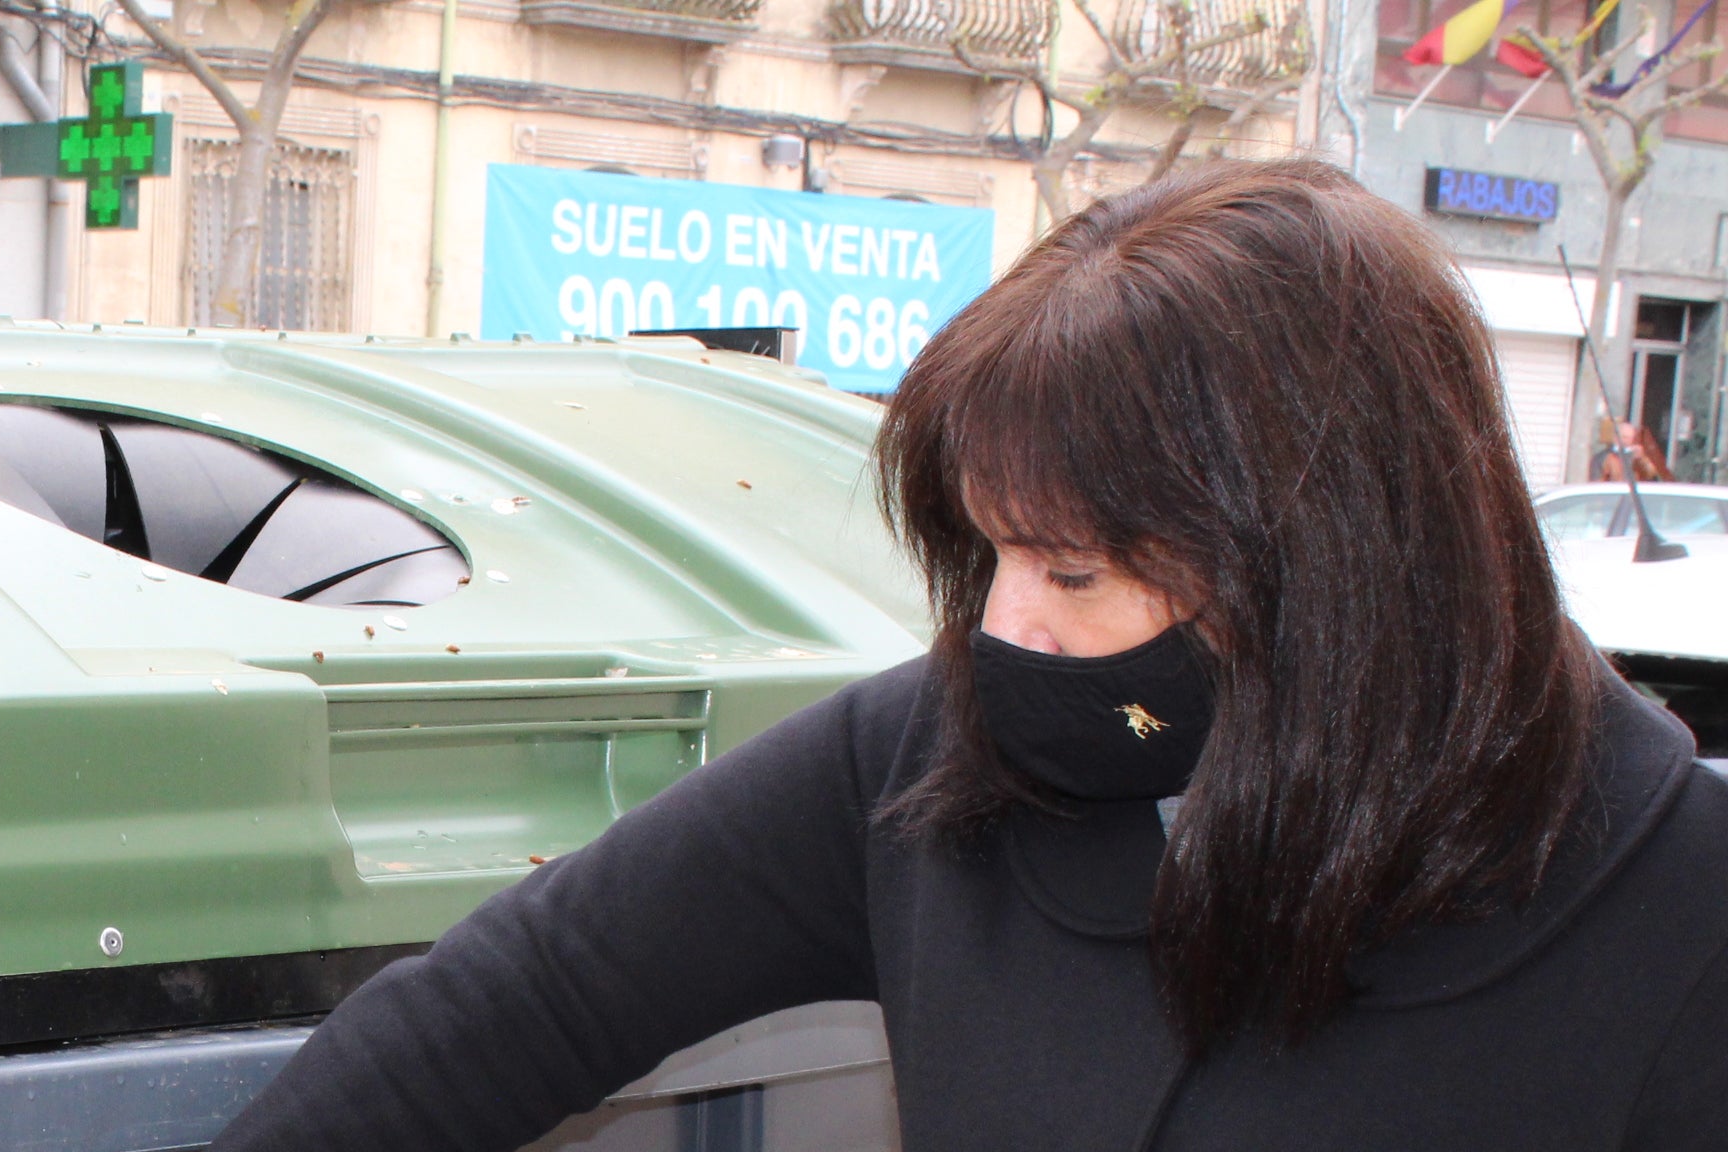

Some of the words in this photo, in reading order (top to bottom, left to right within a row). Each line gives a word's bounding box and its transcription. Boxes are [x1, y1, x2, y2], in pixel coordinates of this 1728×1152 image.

[1437, 168, 1556, 219] RABAJOS
[551, 198, 711, 264] SUELO
[724, 214, 787, 271] EN
[801, 221, 942, 284] VENTA
[558, 275, 675, 343] 900
[827, 294, 932, 370] 686
